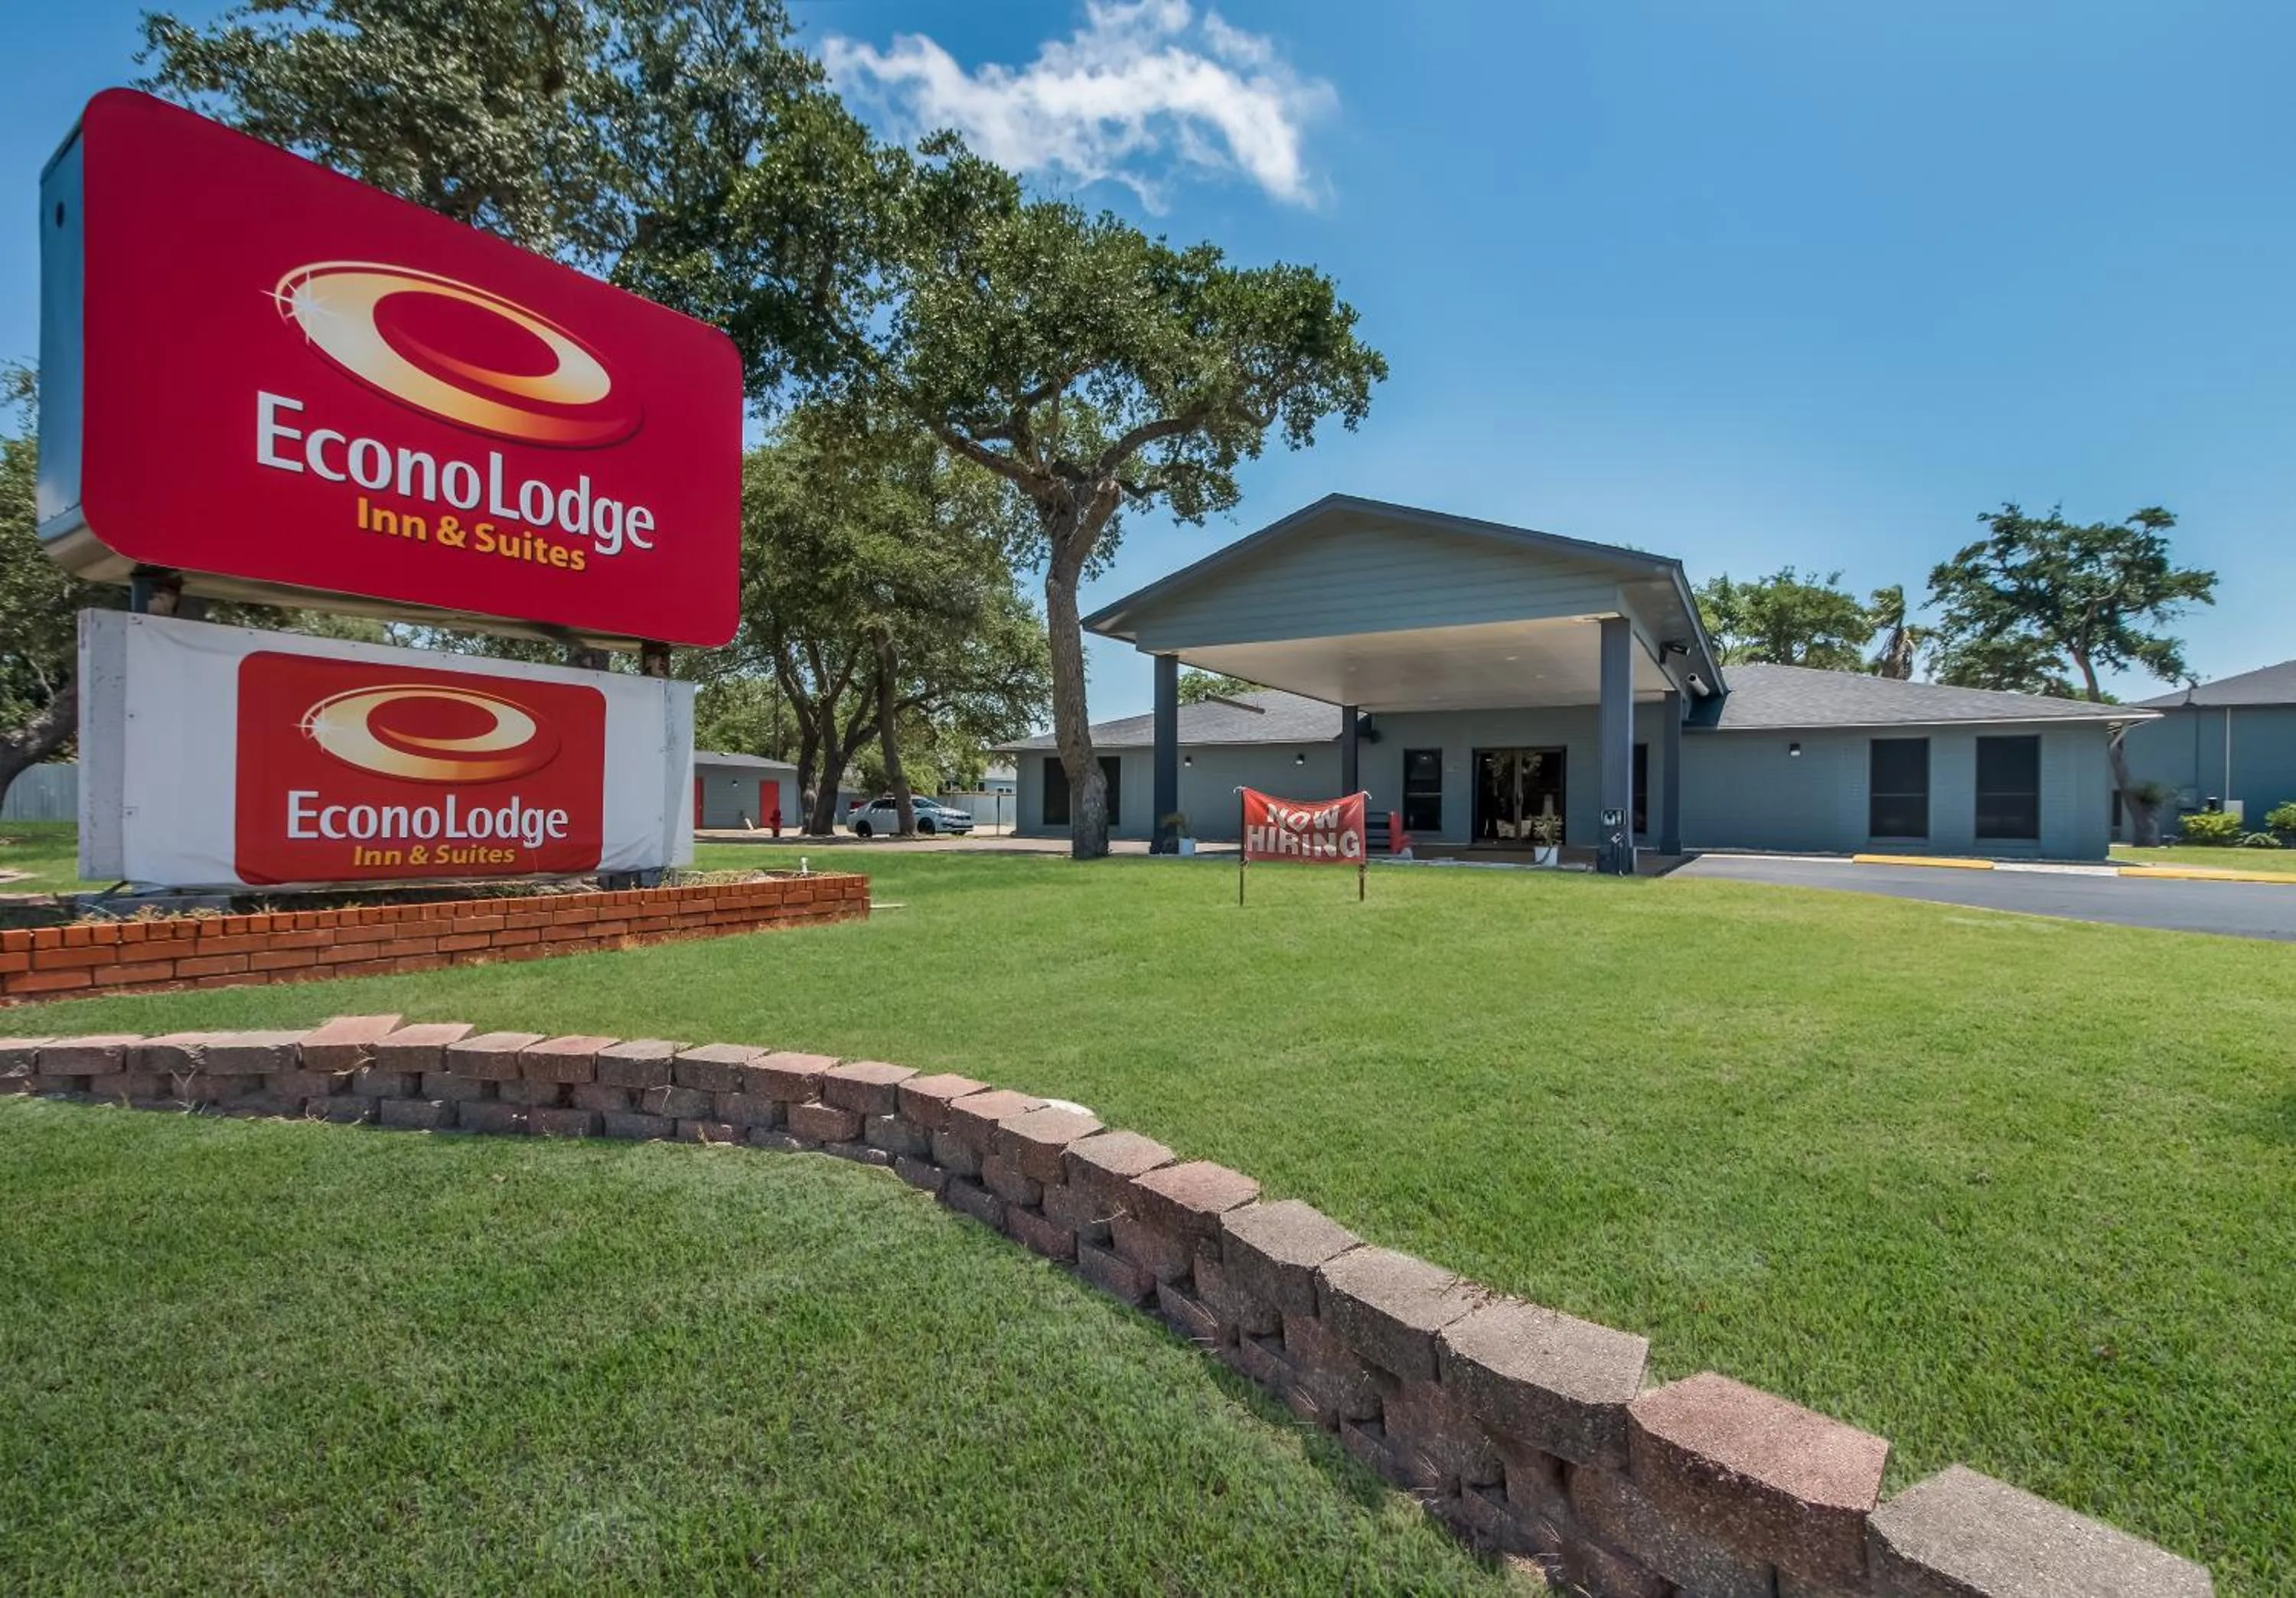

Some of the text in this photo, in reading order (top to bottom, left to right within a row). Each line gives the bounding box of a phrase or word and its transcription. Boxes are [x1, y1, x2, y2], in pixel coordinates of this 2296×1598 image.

[256, 390, 655, 556] EconoLodge
[357, 497, 586, 572] Inn & Suites
[287, 791, 569, 847] EconoLodge
[1267, 804, 1339, 832] NOW
[353, 844, 516, 866] Inn & Suites
[1247, 824, 1360, 857] HIRING
